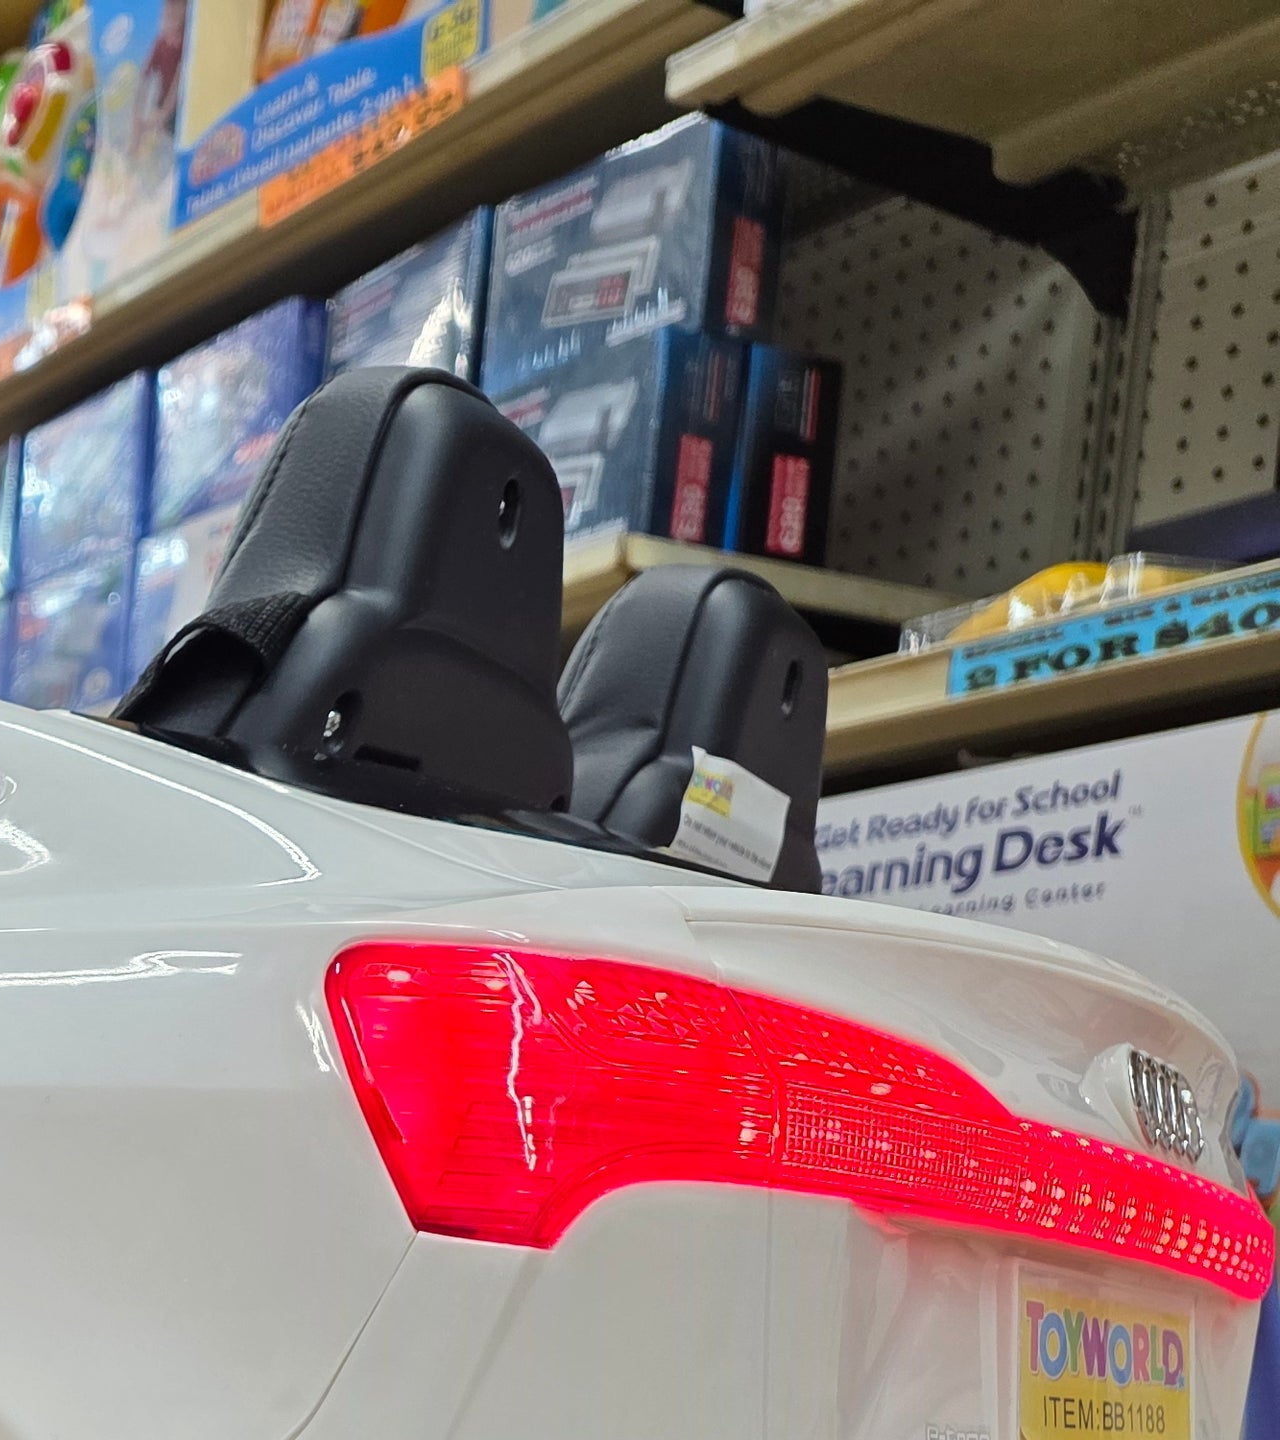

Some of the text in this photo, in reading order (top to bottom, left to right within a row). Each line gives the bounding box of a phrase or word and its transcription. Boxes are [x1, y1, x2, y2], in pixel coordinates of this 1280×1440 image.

[1012, 633, 1140, 682] FOR
[865, 803, 960, 838] Ready
[964, 796, 1009, 826] for
[1011, 767, 1122, 818] School
[821, 809, 1127, 896] earning Desk
[1025, 1300, 1184, 1387] TOYWORLD
[1043, 1395, 1166, 1433] ITEM:BB1188
